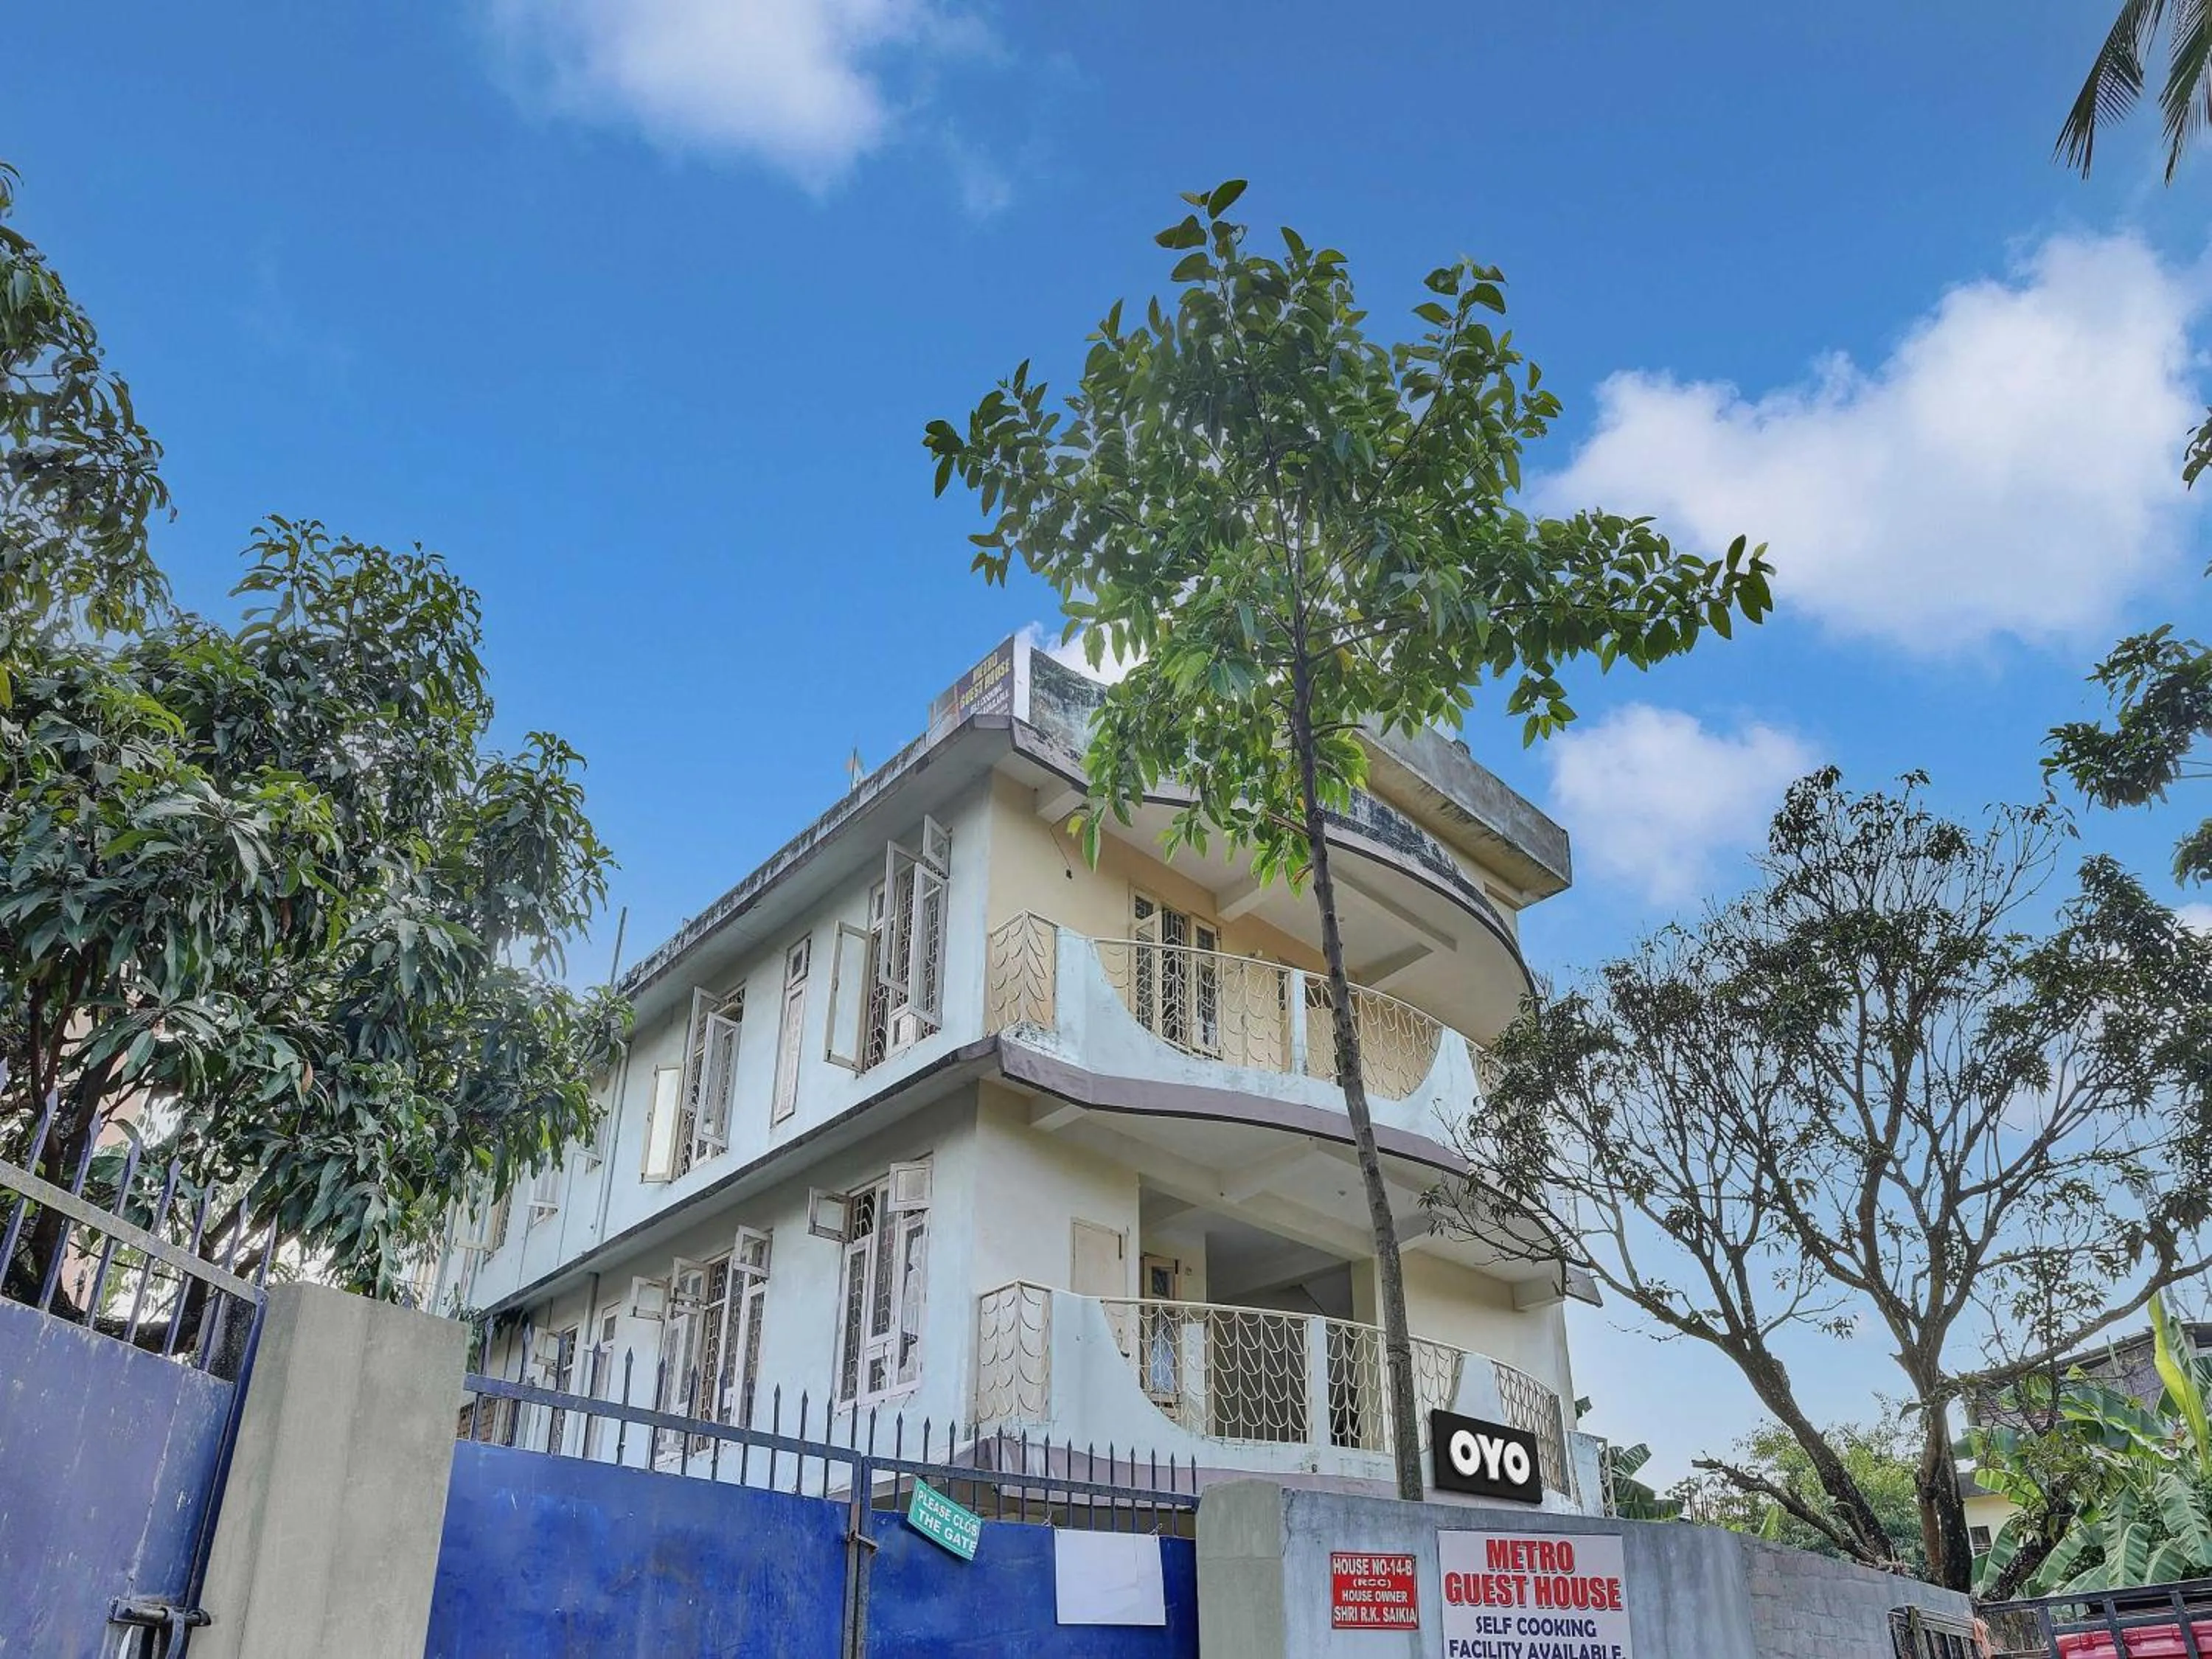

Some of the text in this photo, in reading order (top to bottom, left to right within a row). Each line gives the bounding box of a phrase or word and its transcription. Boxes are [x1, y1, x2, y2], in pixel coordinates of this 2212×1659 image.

[984, 658, 1009, 689] HOUSE
[1450, 1430, 1531, 1485] OYO
[917, 1490, 978, 1537] PLEASE CLOS
[918, 1509, 977, 1553] THE GATE
[1333, 1557, 1369, 1575] HOUSE
[1486, 1539, 1574, 1573] METRO
[1343, 1590, 1408, 1603] HOUSE OWNER
[1444, 1572, 1622, 1610] GUEST HOUSE
[1333, 1606, 1416, 1623] SHRI R.K. SAIKIA
[1476, 1616, 1597, 1638] SELF COOKING
[1449, 1640, 1523, 1659] FACILITY
